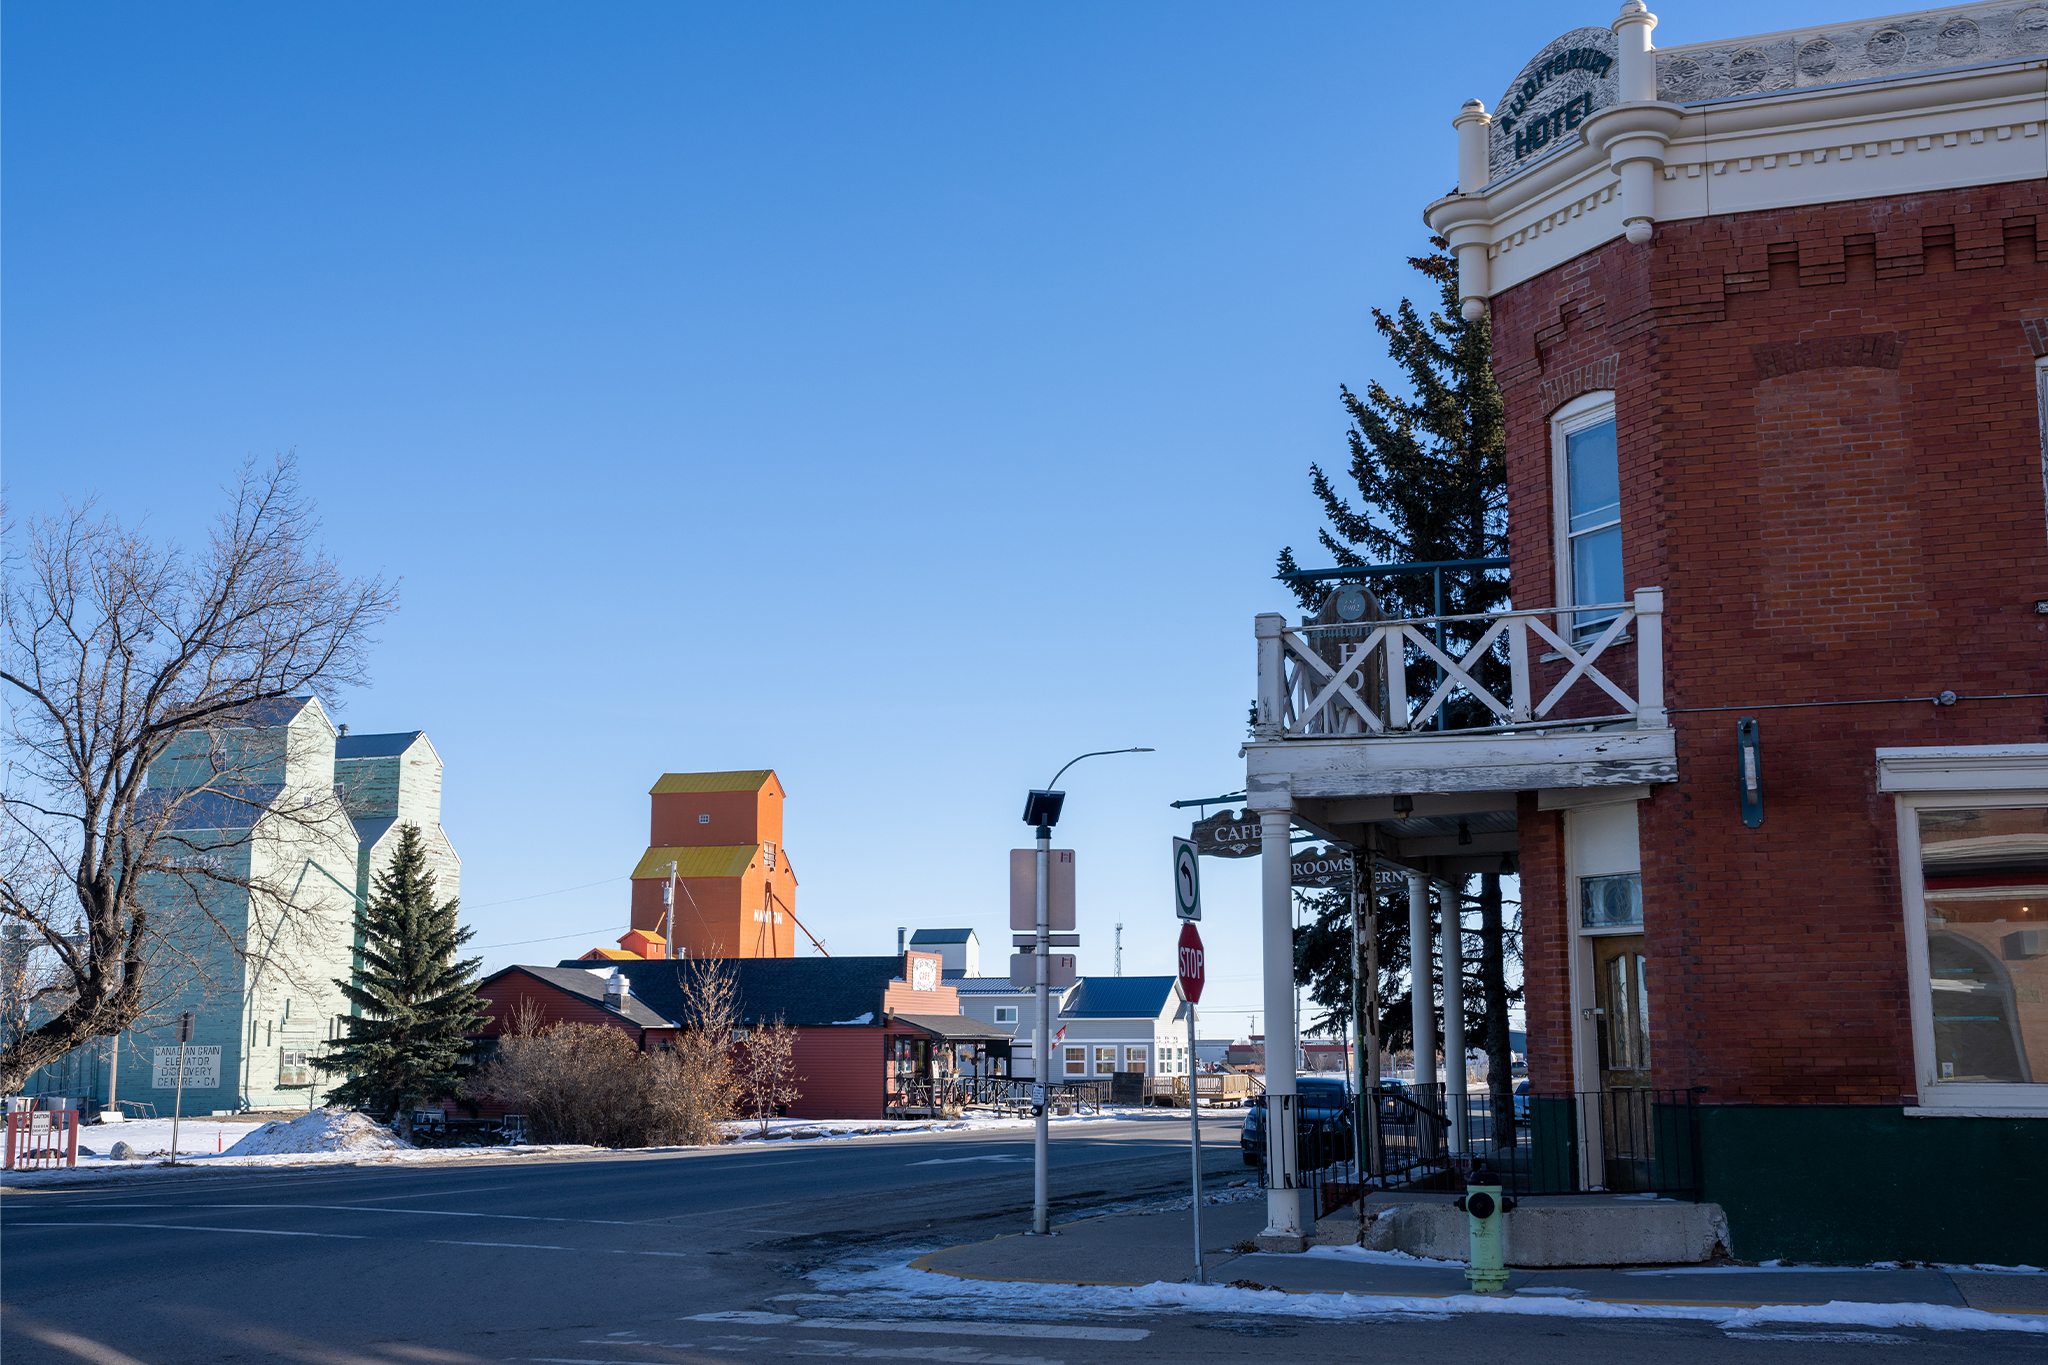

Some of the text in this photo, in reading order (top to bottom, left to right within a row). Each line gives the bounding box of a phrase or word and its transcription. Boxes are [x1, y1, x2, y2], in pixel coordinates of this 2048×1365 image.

[1501, 47, 1613, 135] AUDITORIUM
[1515, 91, 1601, 159] HOTEL
[1342, 604, 1360, 612] 1902
[1214, 824, 1263, 843] CAFE
[1292, 858, 1353, 876] ROOMS
[1180, 946, 1203, 979] STOP
[919, 971, 931, 981] CAFE
[155, 1046, 220, 1056] CANADAN GRAIN
[157, 1077, 193, 1087] CENRE
